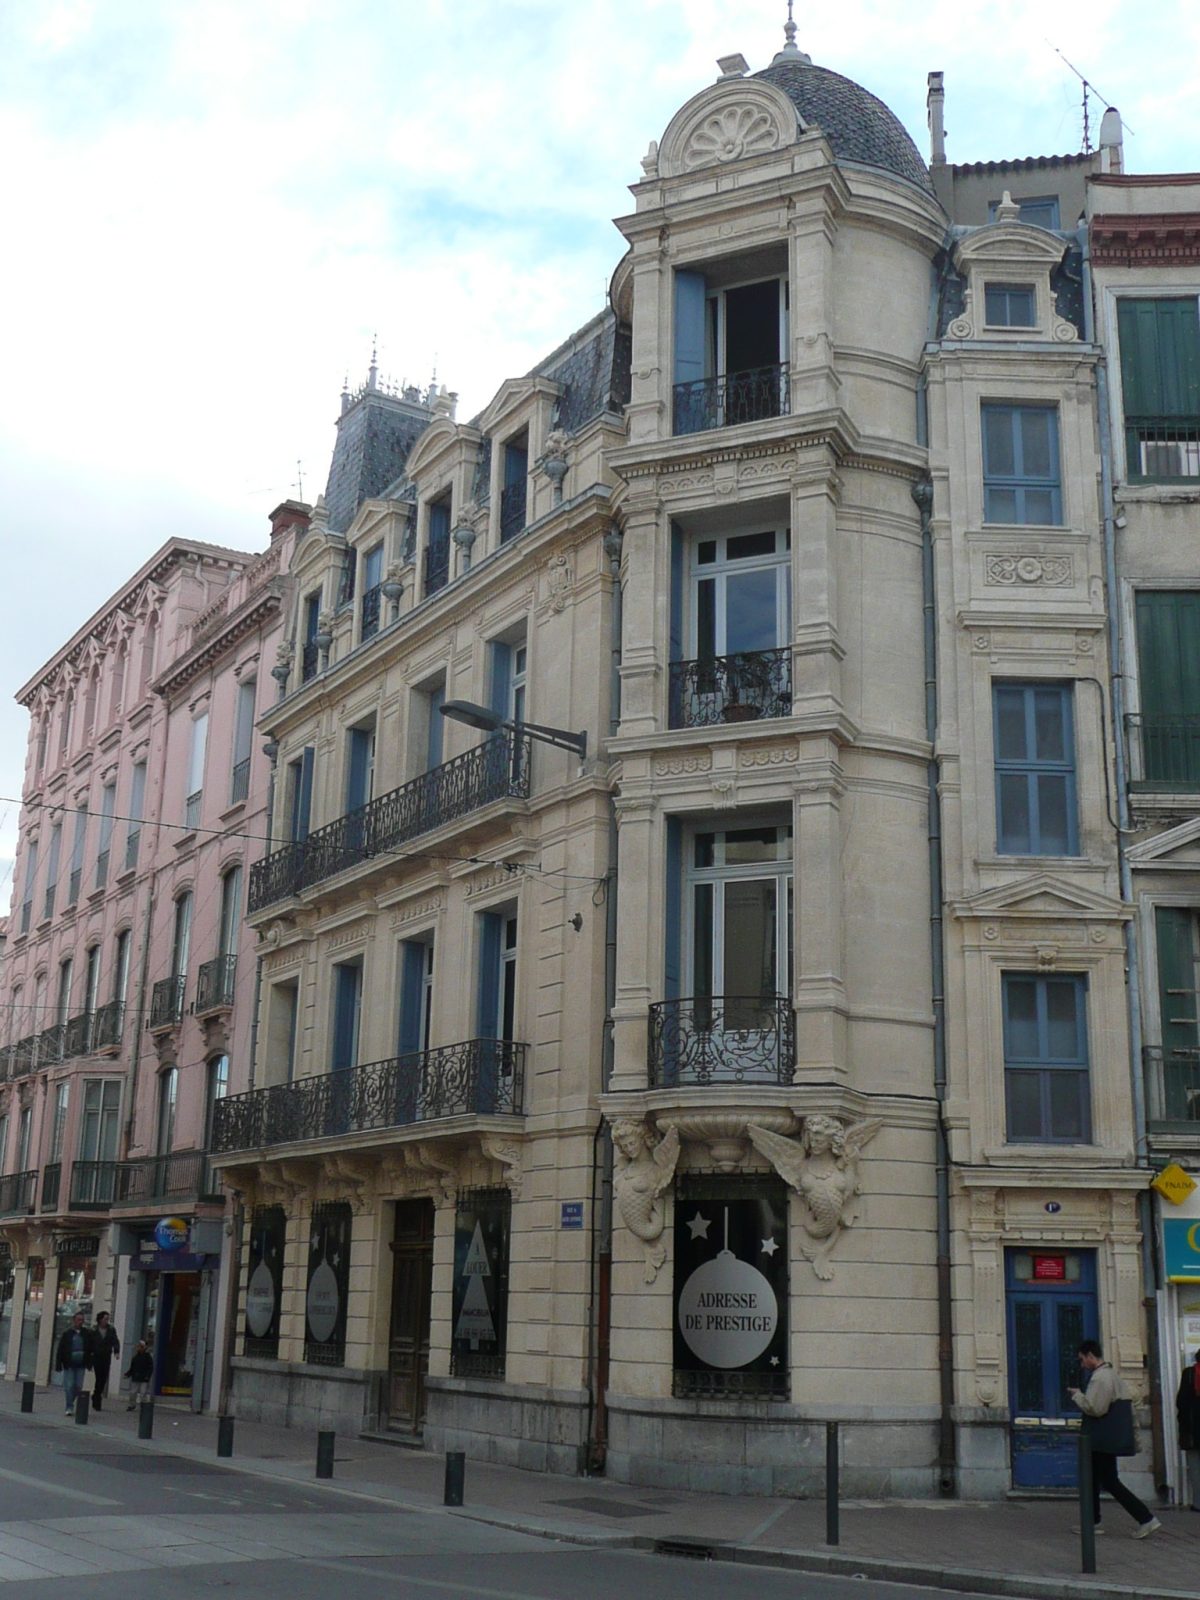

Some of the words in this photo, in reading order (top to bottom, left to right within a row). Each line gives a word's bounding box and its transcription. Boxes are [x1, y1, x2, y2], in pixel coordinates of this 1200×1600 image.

[1165, 1180, 1192, 1190] FNAIM
[159, 1227, 188, 1237] Thomas
[697, 1292, 757, 1309] ADRESSE
[685, 1314, 702, 1330] DE
[706, 1315, 771, 1332] PRESTIGE
